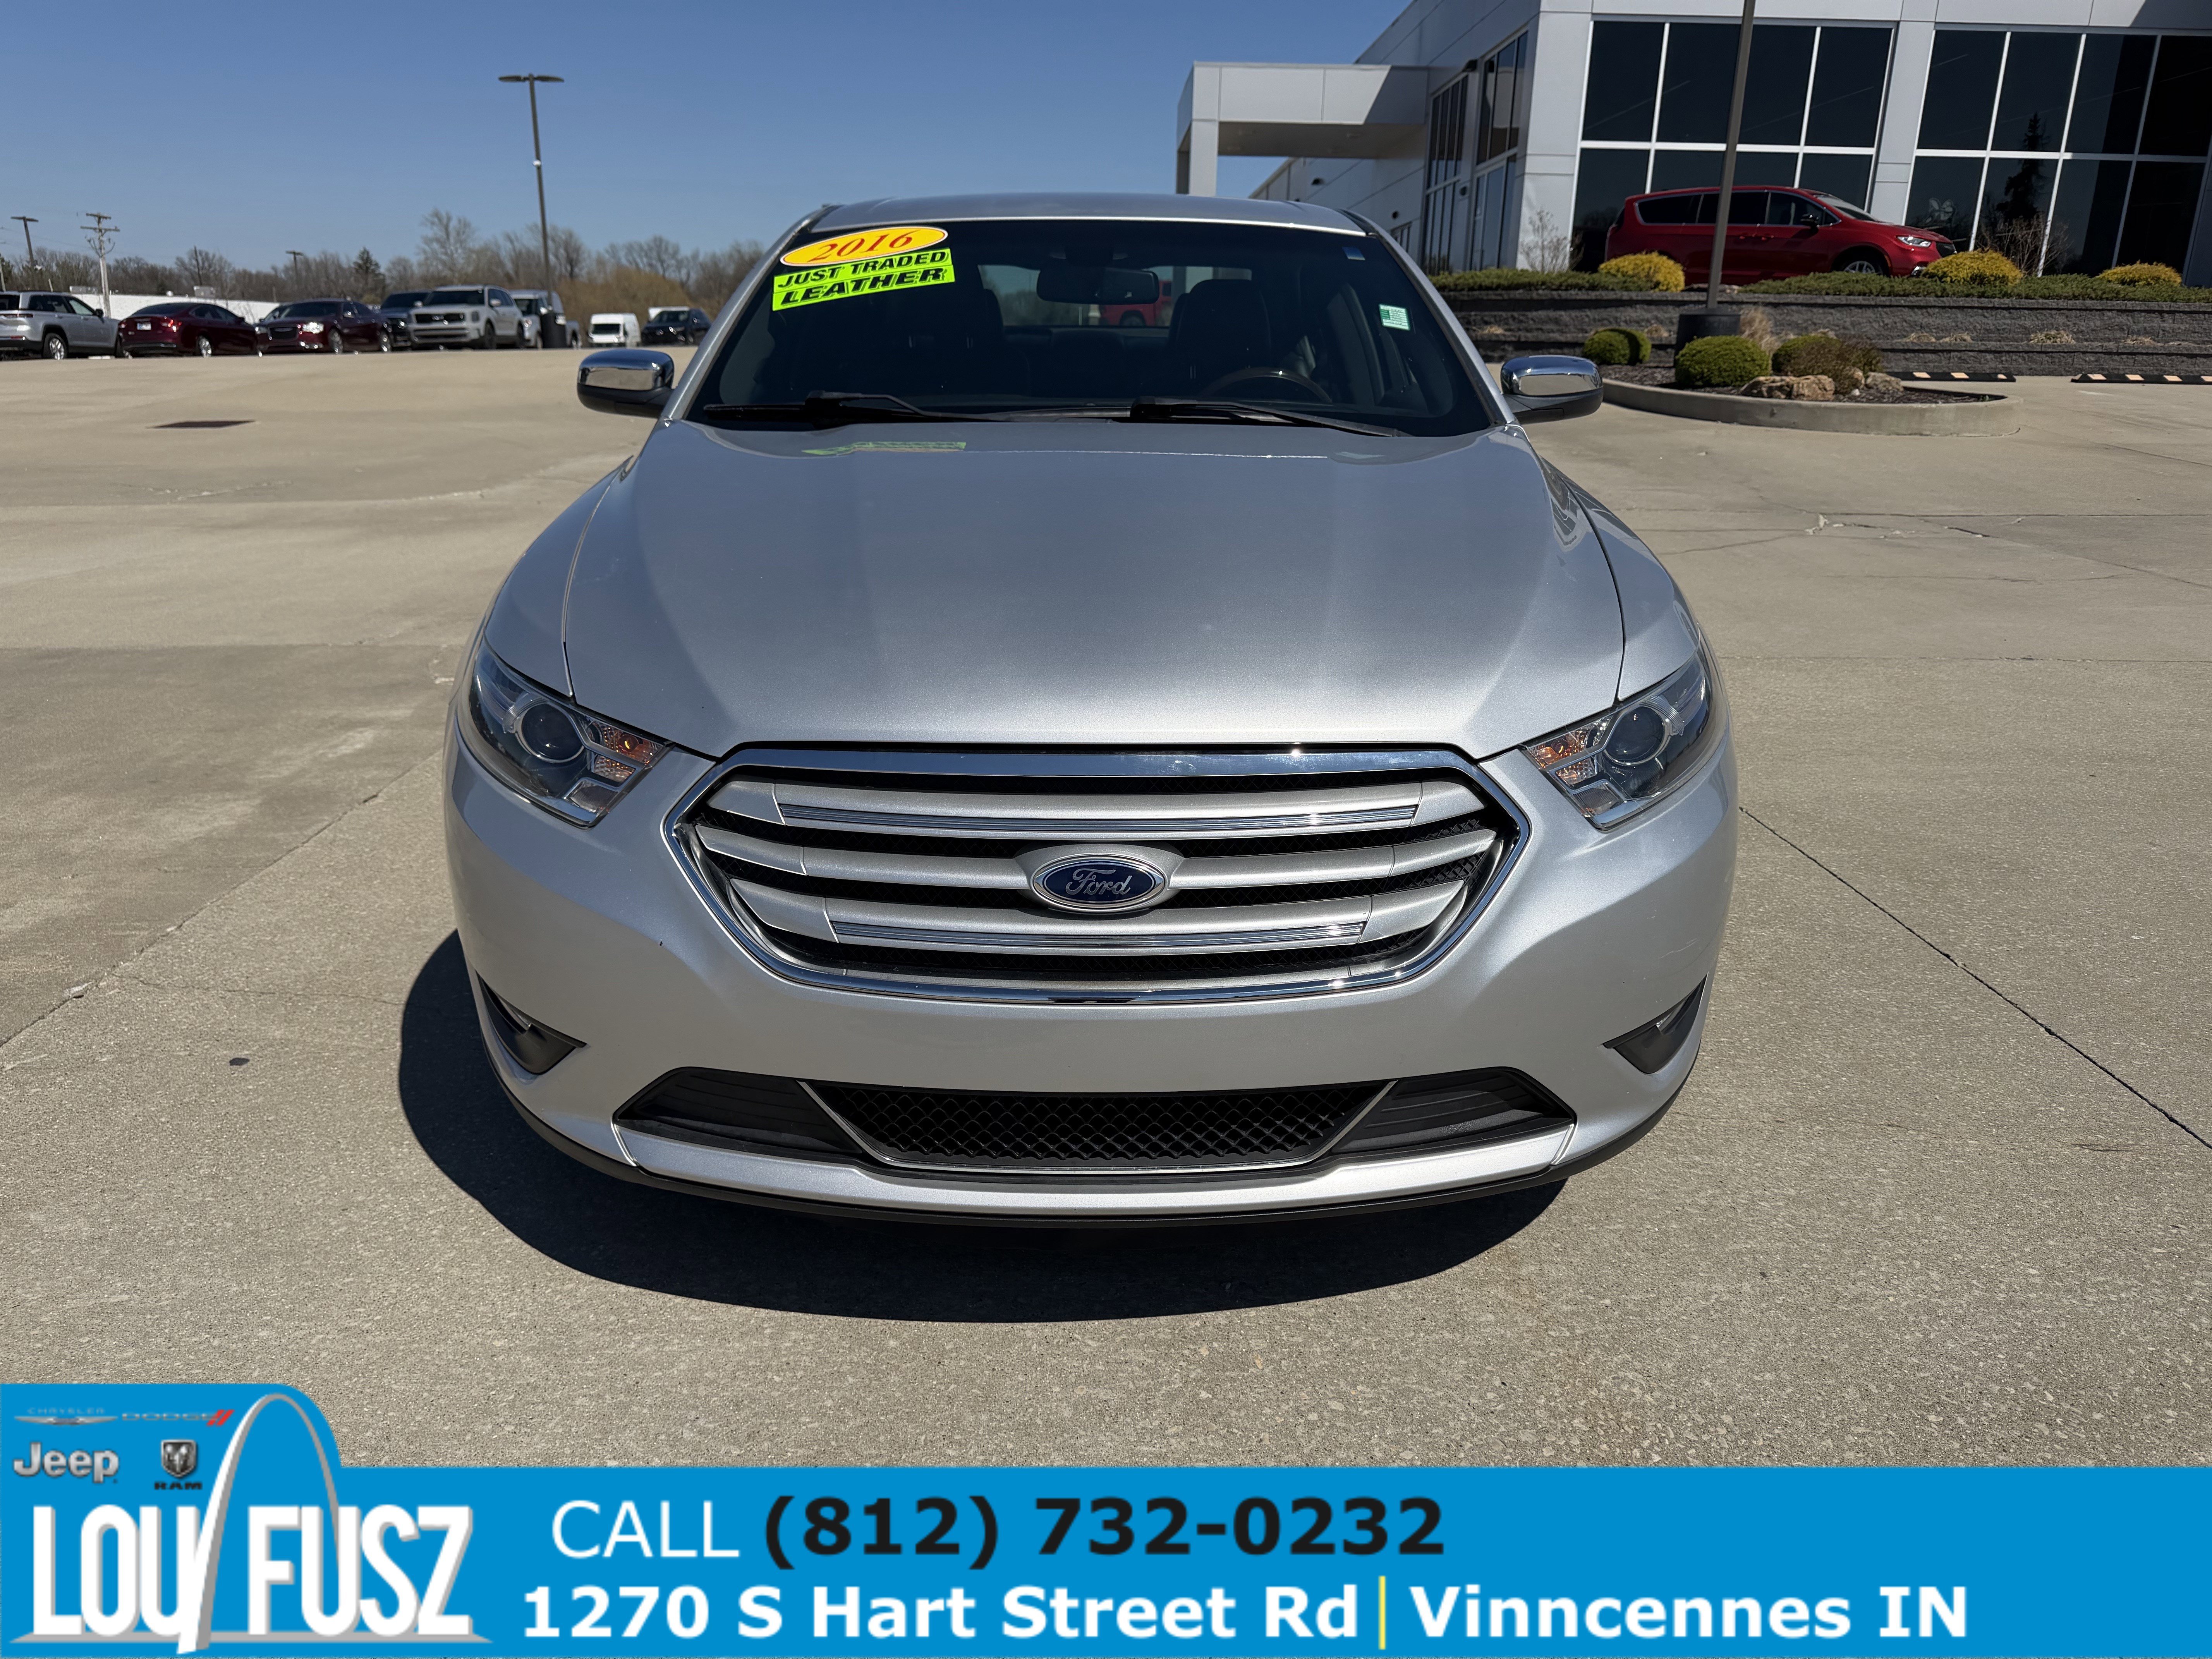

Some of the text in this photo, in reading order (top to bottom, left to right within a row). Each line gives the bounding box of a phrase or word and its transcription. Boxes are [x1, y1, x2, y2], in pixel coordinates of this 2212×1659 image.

[807, 230, 921, 262] 2016
[778, 251, 947, 288] JUST TRADED
[781, 267, 945, 306] LEATHER
[1065, 868, 1132, 895] Ford
